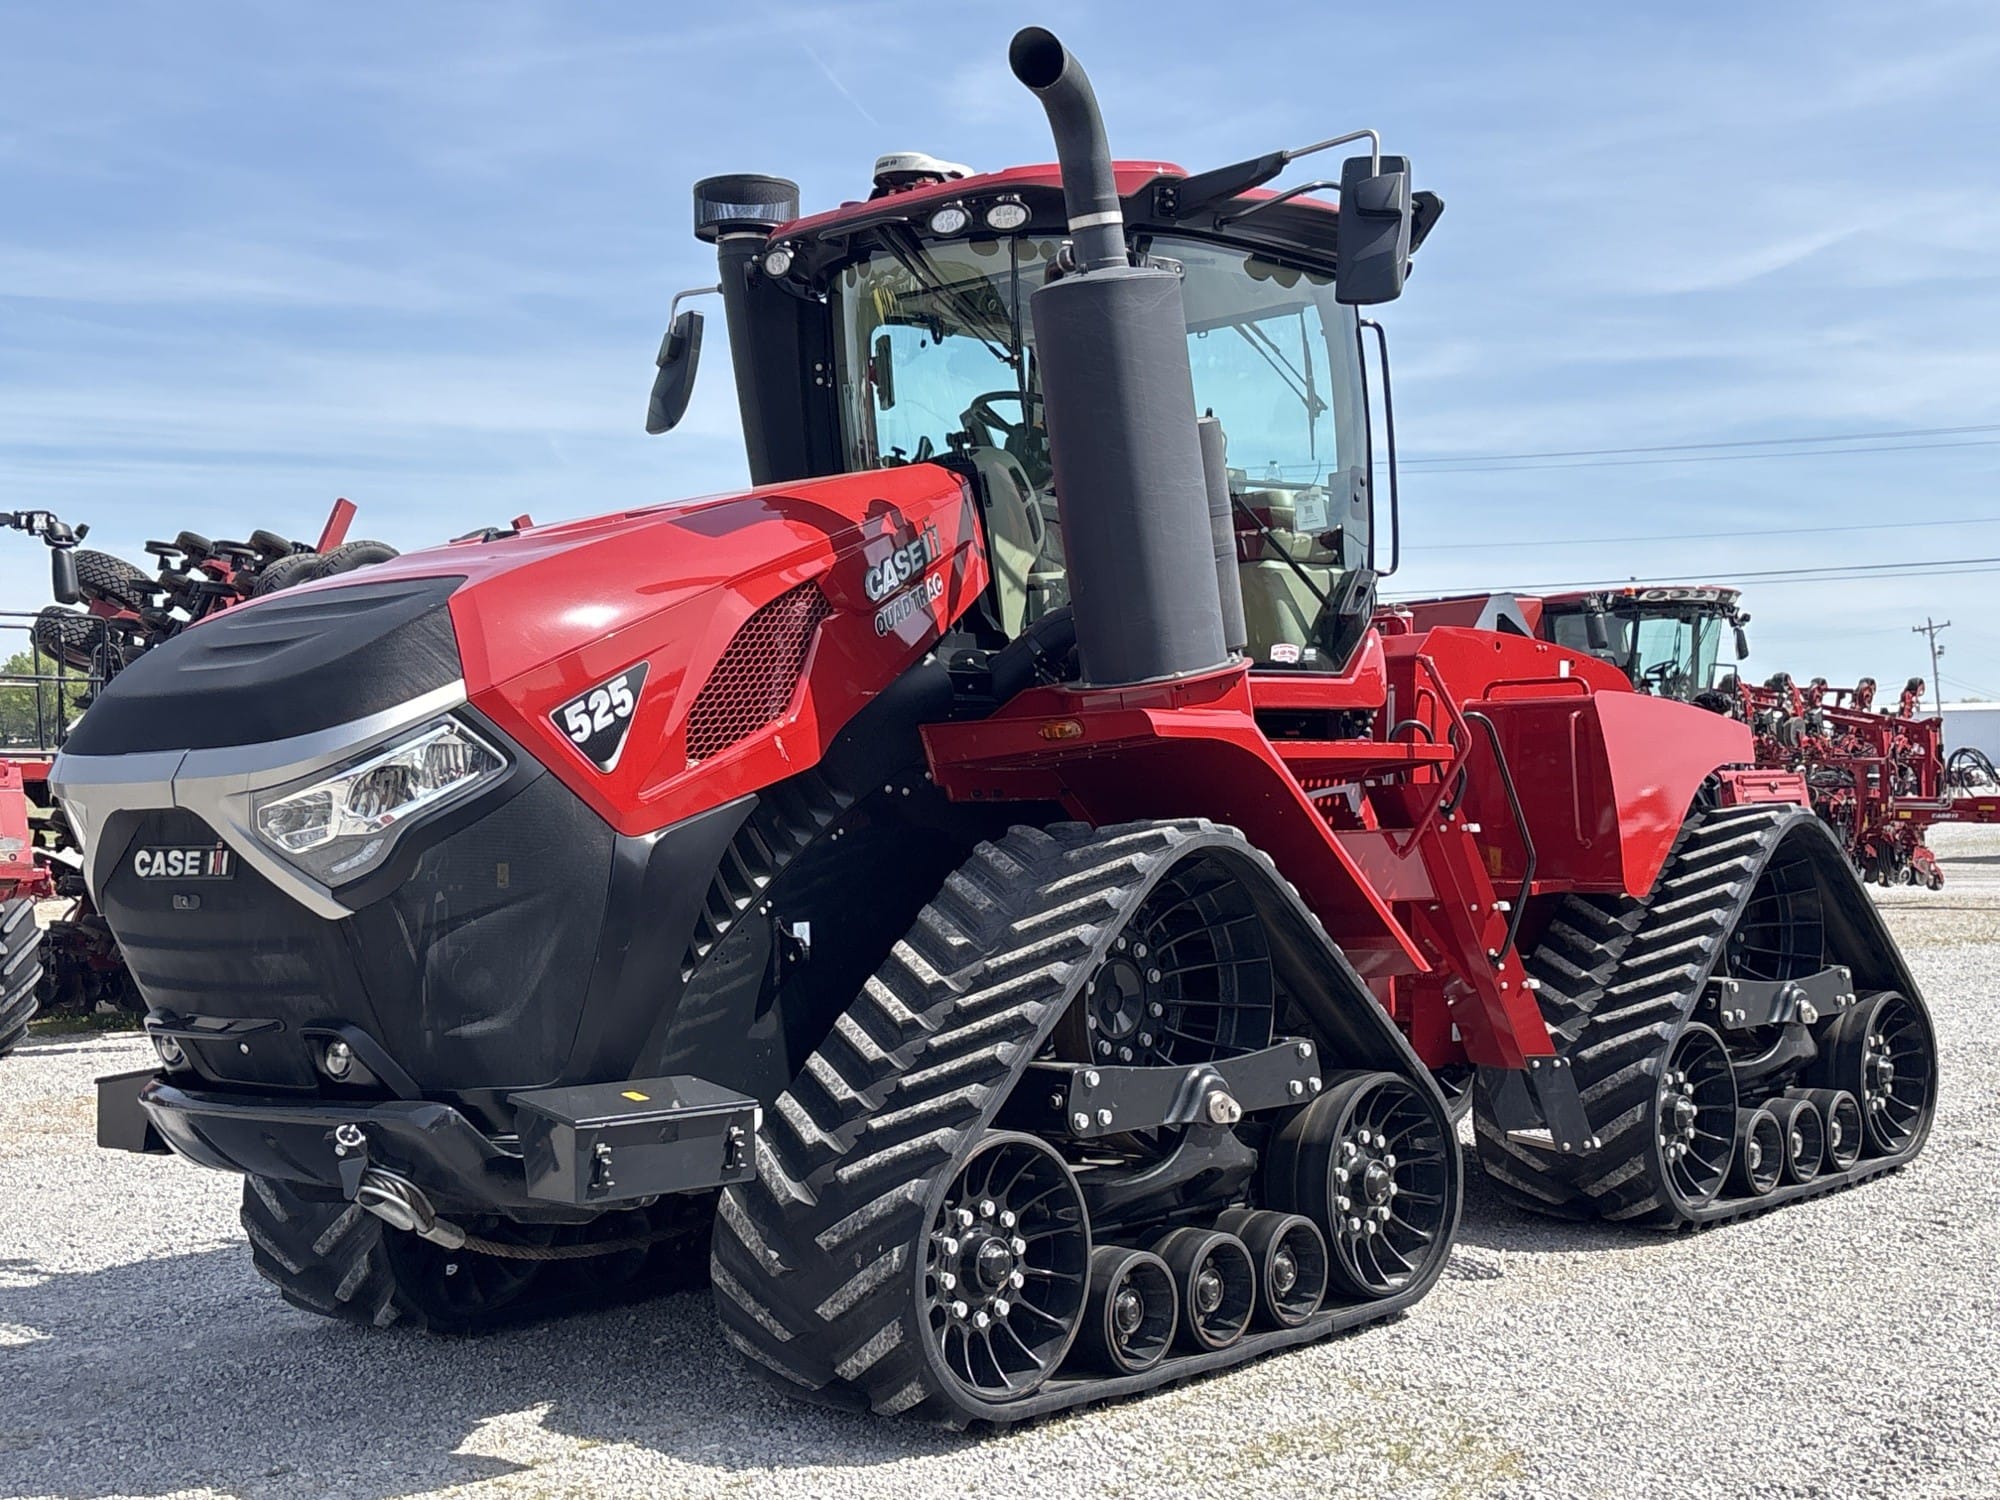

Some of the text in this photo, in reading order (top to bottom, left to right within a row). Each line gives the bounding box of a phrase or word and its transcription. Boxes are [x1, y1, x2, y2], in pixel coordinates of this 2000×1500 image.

[863, 540, 925, 602] CASE
[563, 675, 634, 743] 525
[134, 849, 201, 877] CASE
